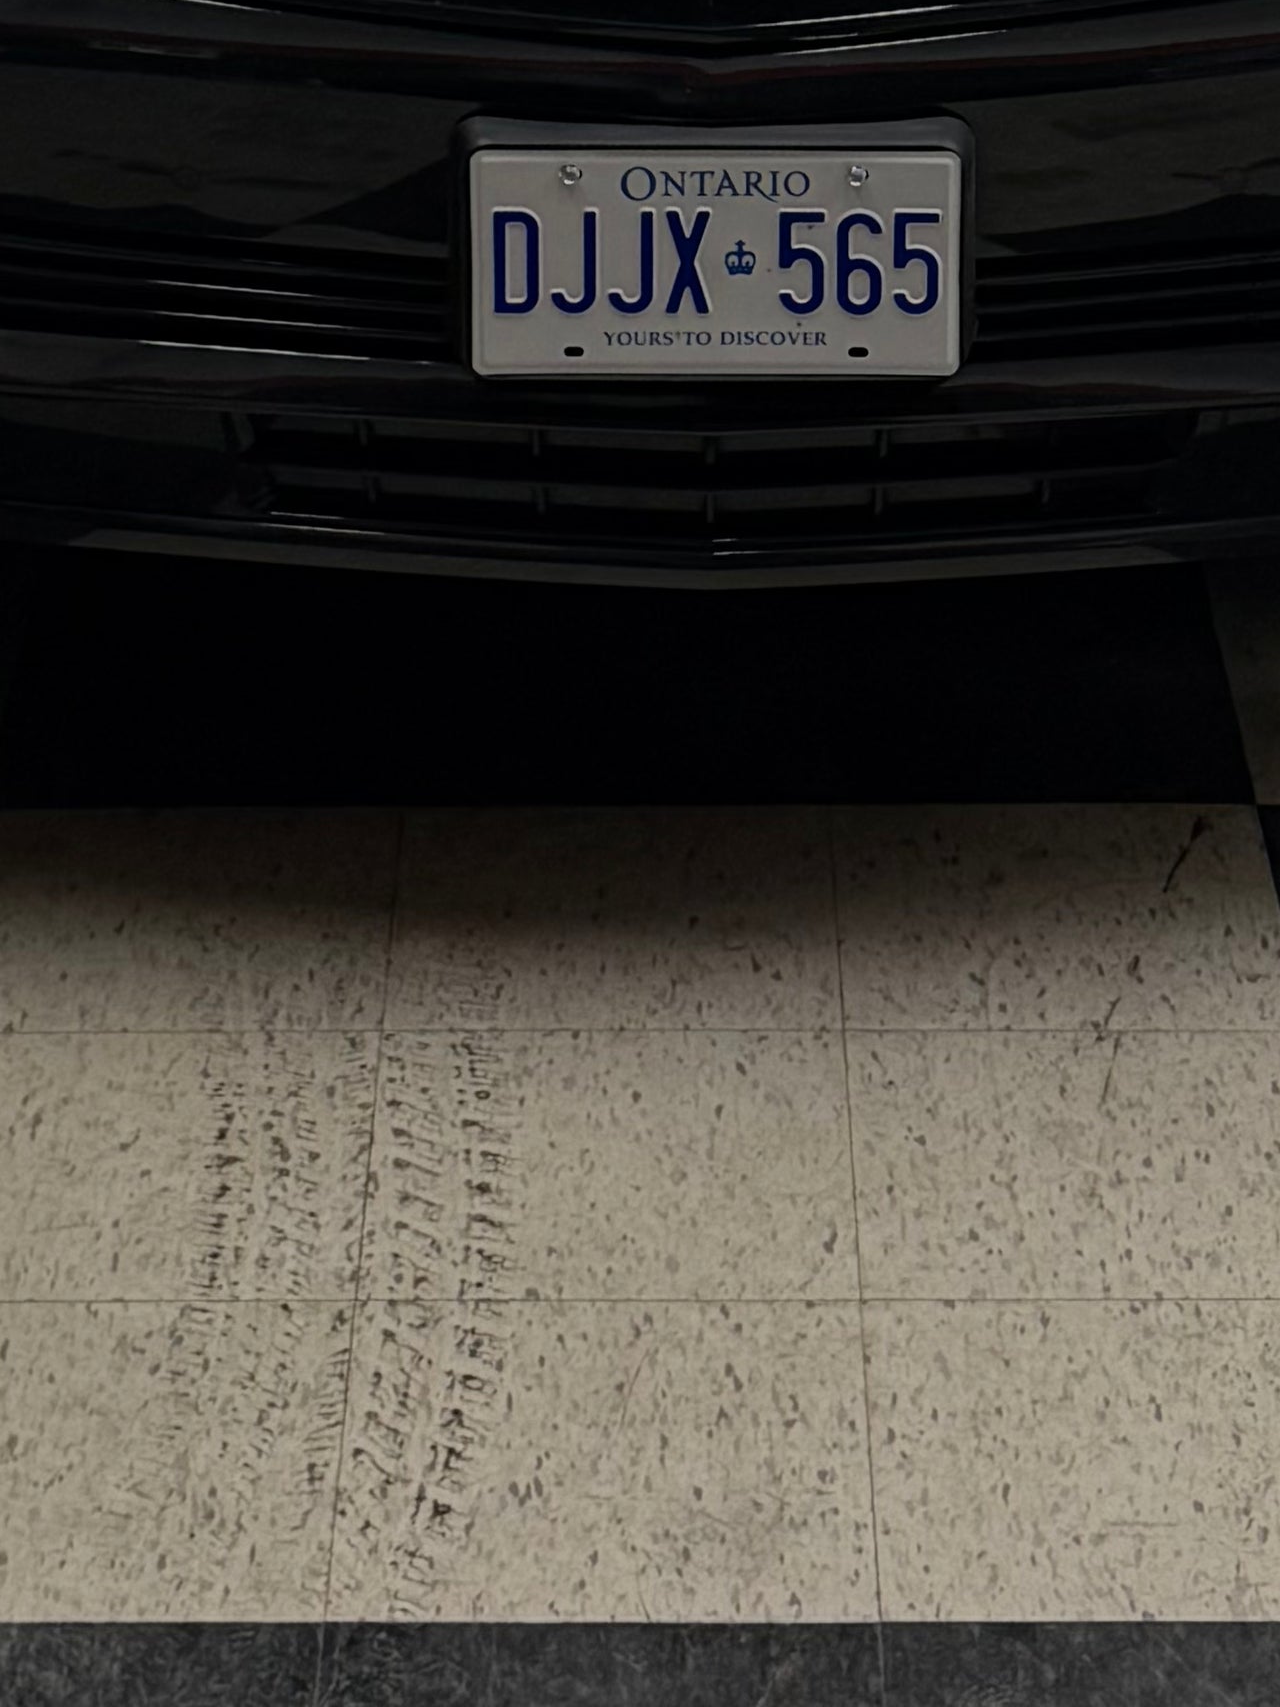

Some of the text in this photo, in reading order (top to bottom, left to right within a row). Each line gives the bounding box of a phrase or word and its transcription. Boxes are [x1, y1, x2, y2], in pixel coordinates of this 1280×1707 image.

[620, 166, 810, 202] ONTARIO
[492, 209, 942, 316] DJJX 565
[603, 330, 828, 347] YOURS TO DISCOVER
